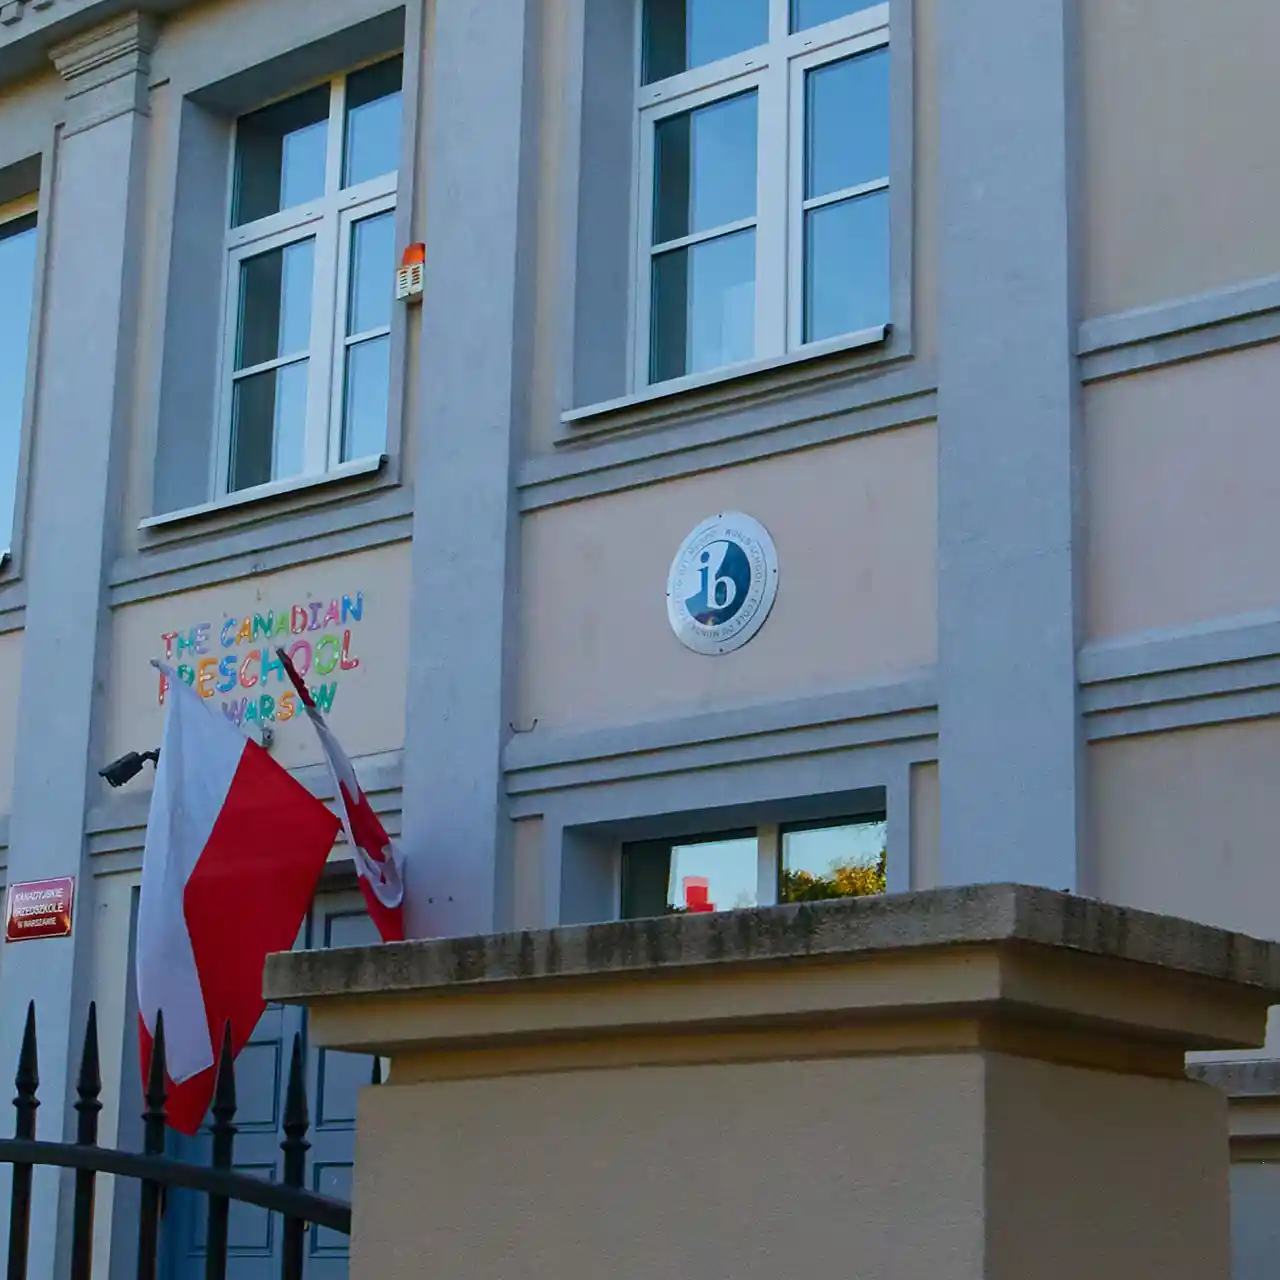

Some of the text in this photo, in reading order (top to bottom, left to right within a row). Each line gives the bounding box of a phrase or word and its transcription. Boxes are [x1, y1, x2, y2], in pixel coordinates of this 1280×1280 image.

[696, 550, 737, 609] ib
[161, 590, 364, 660] THE CANADIAN
